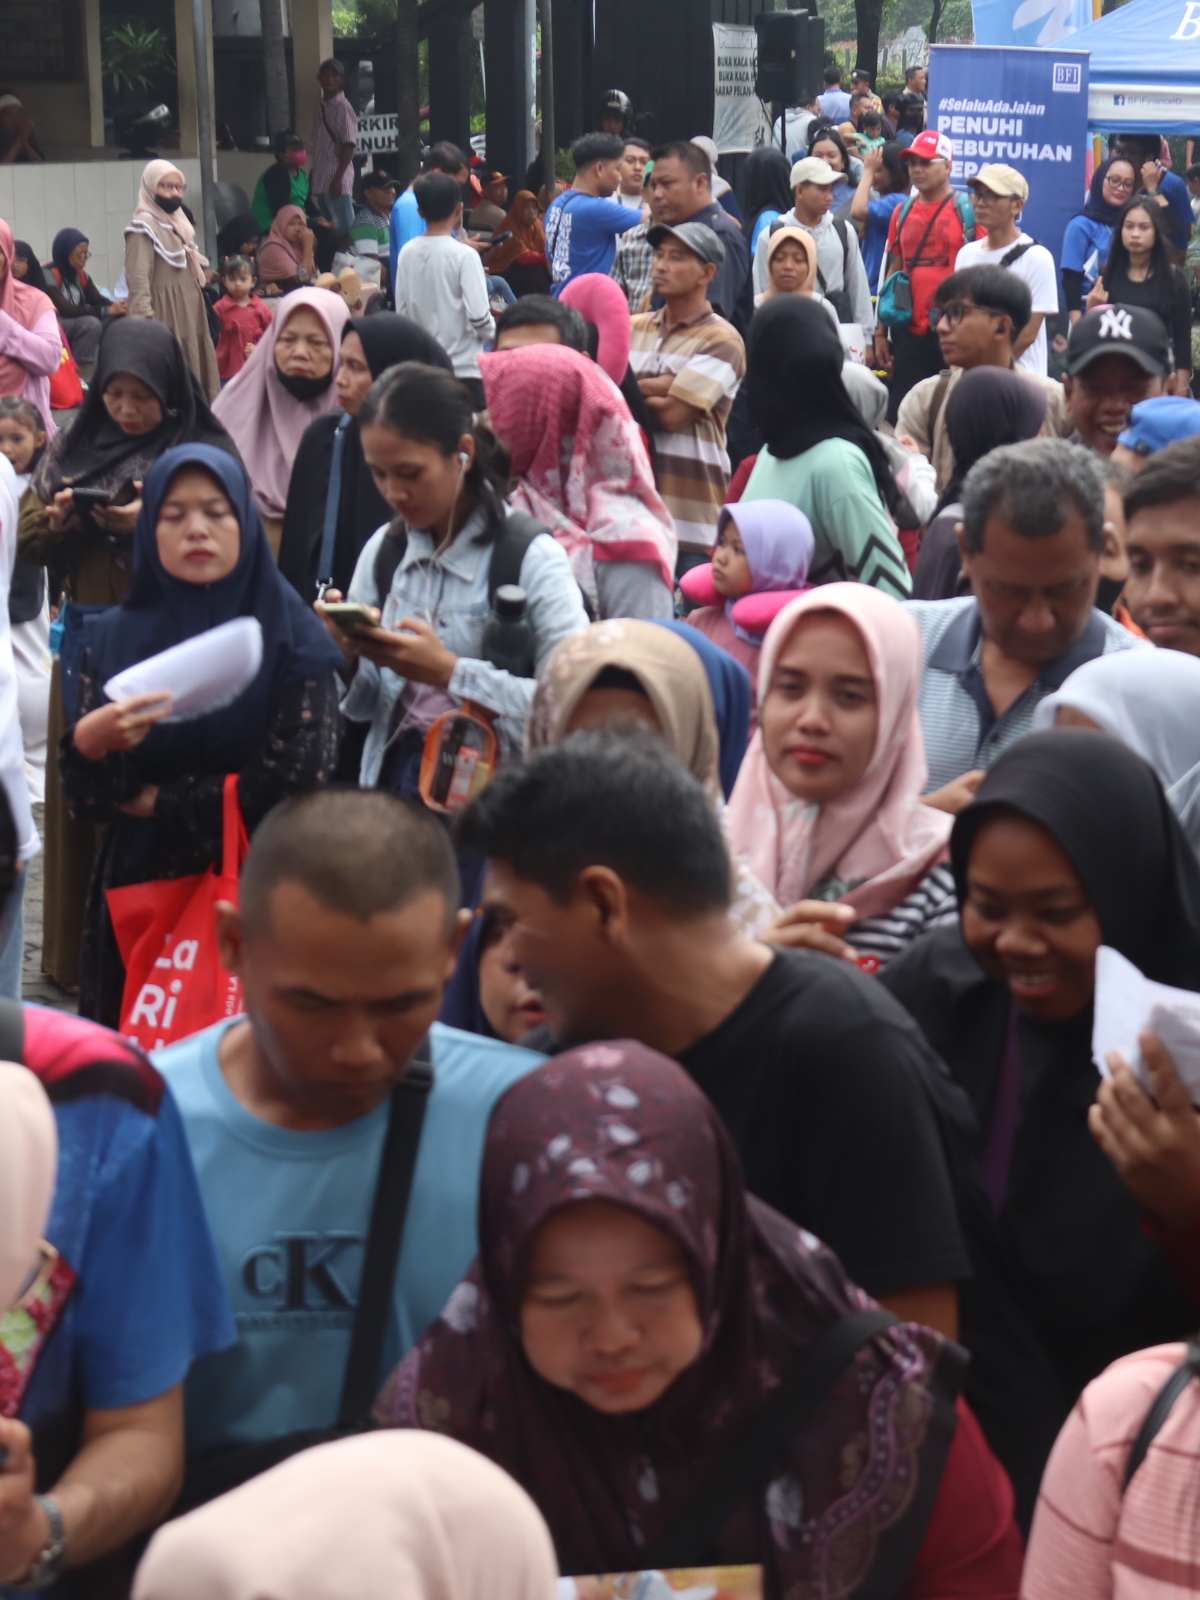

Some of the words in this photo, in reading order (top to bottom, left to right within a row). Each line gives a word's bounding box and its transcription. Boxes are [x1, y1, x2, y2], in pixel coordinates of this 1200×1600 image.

[1056, 66, 1079, 83] BFI
[938, 97, 1046, 116] #SelaluAdaJalan
[937, 115, 1024, 136] PENUHI
[950, 139, 1073, 163] EBUTUHAN
[130, 979, 183, 1028] Ri
